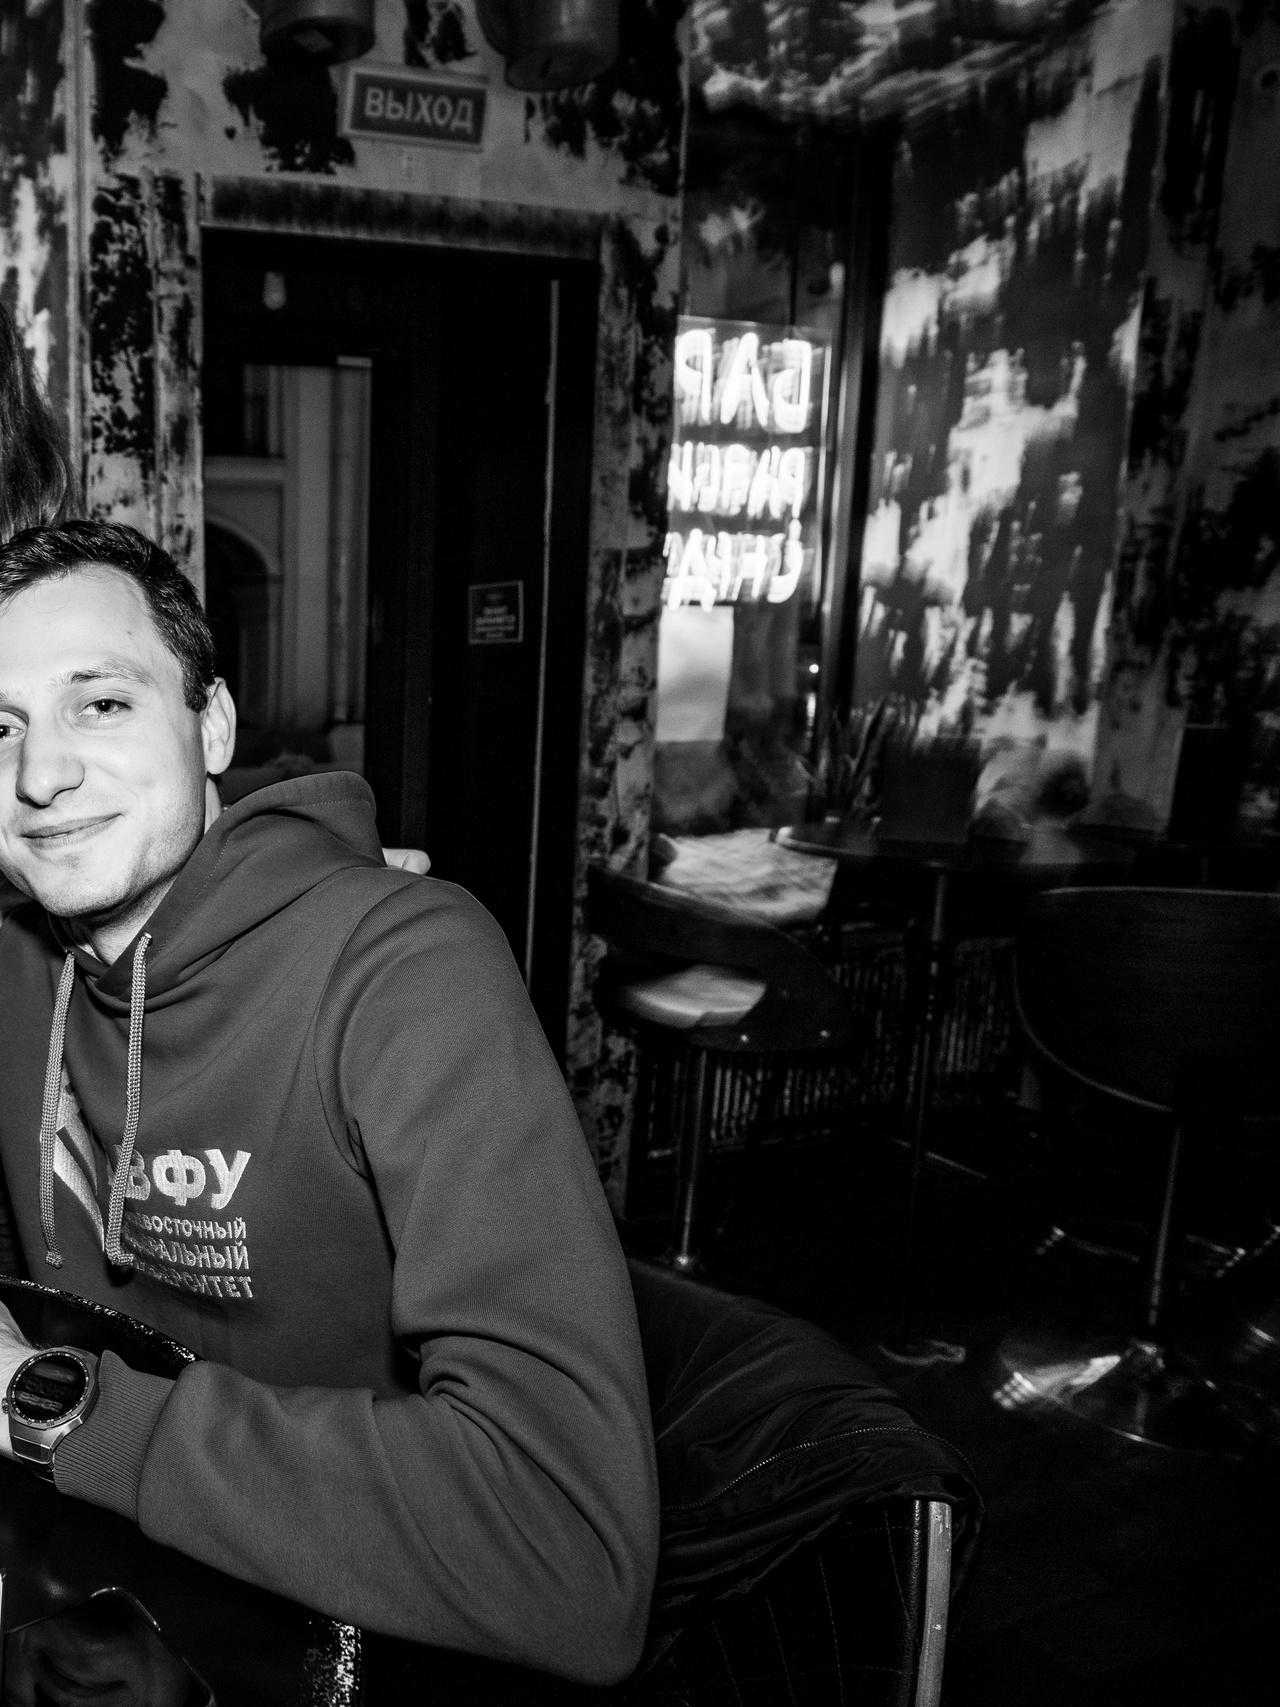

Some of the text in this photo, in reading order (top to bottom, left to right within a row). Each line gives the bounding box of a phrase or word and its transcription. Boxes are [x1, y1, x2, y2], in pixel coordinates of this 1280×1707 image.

[364, 86, 474, 134] ВЫХОД
[108, 1144, 251, 1210] ВФУ
[135, 1212, 246, 1239] ВОСТОЧНЫЙ
